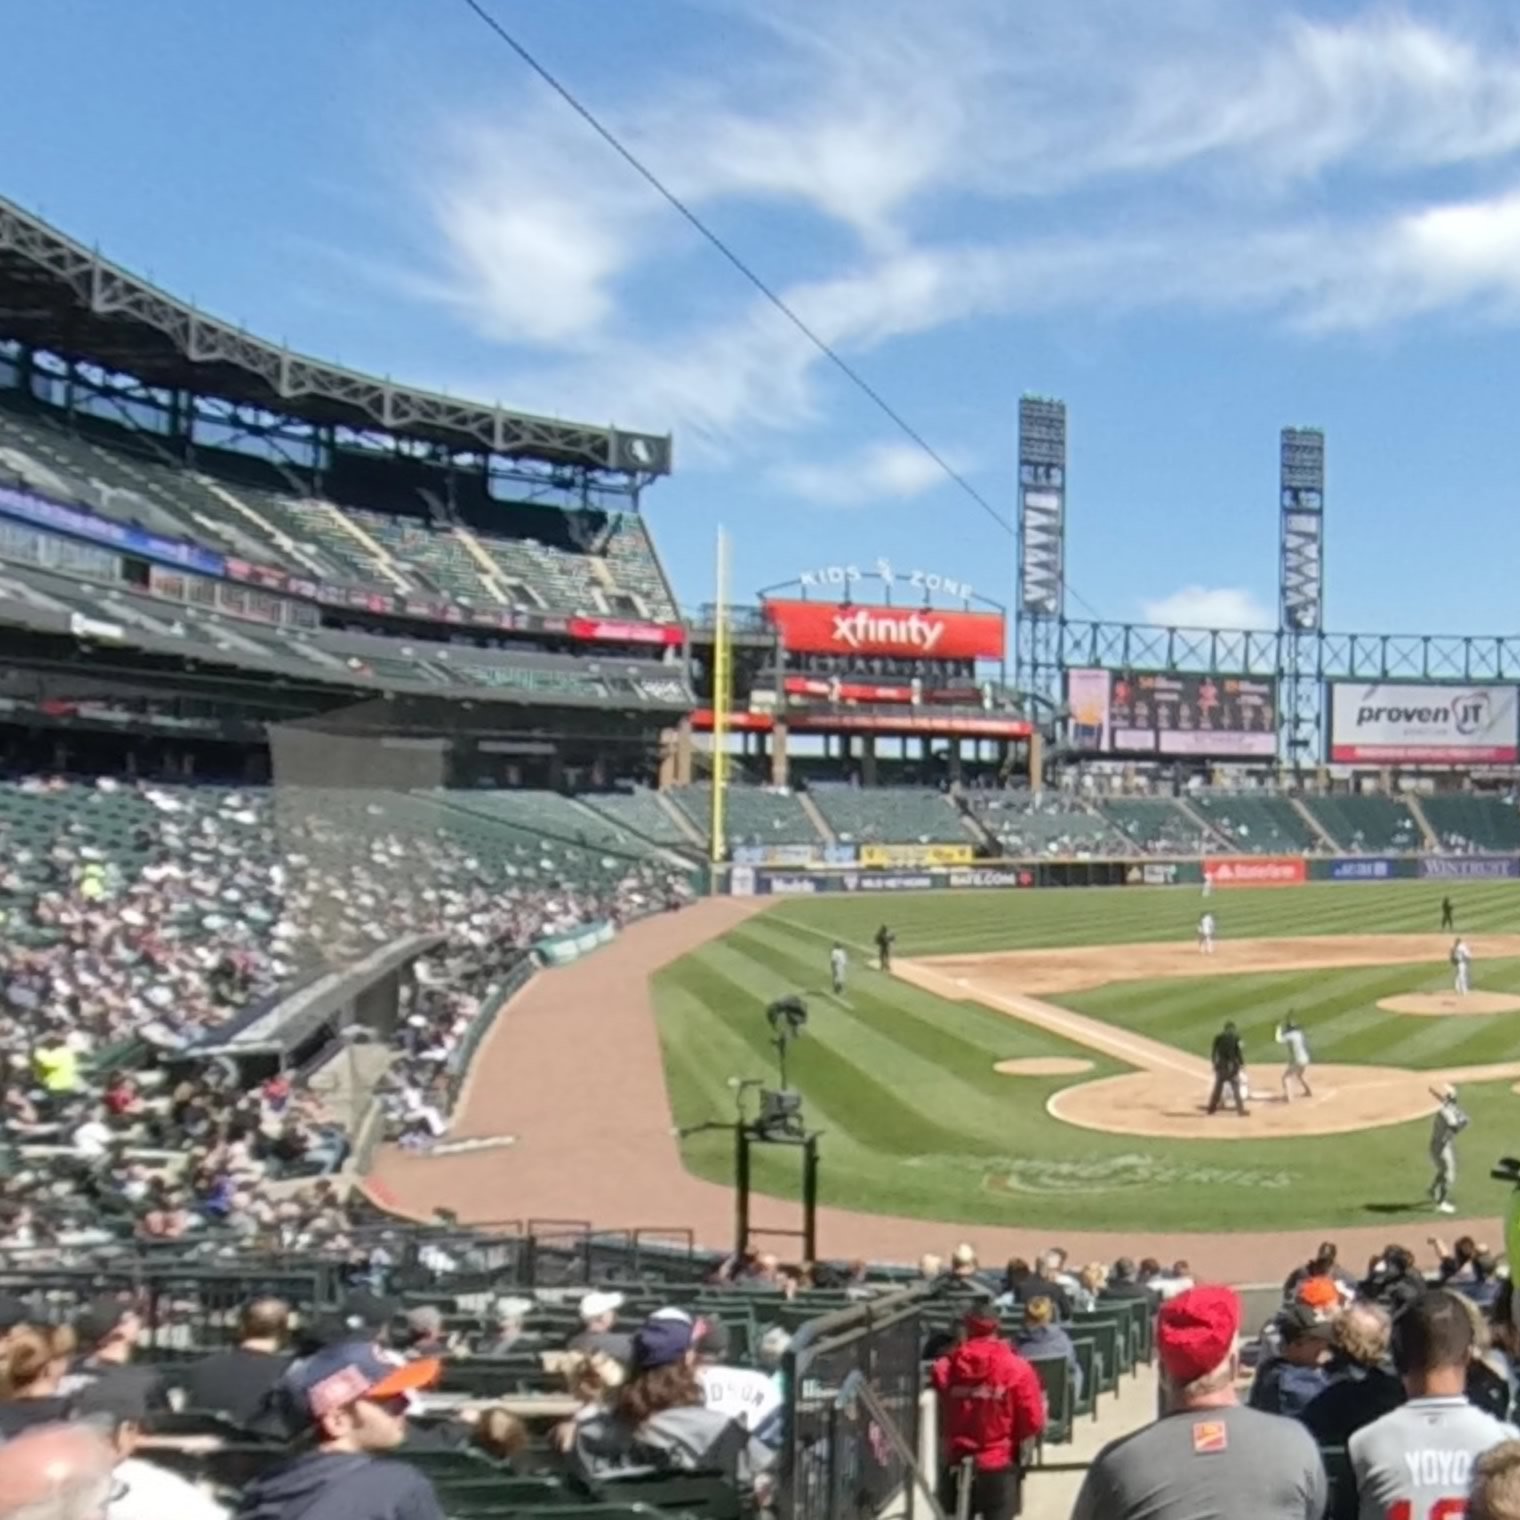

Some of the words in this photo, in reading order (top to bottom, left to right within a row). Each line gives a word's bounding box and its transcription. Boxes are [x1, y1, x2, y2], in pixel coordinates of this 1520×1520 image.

[800, 566, 862, 585] KIDS
[910, 569, 973, 598] ZONE
[832, 611, 944, 650] xfinity
[1357, 704, 1449, 726] proven
[1402, 1448, 1472, 1488] YOYO
